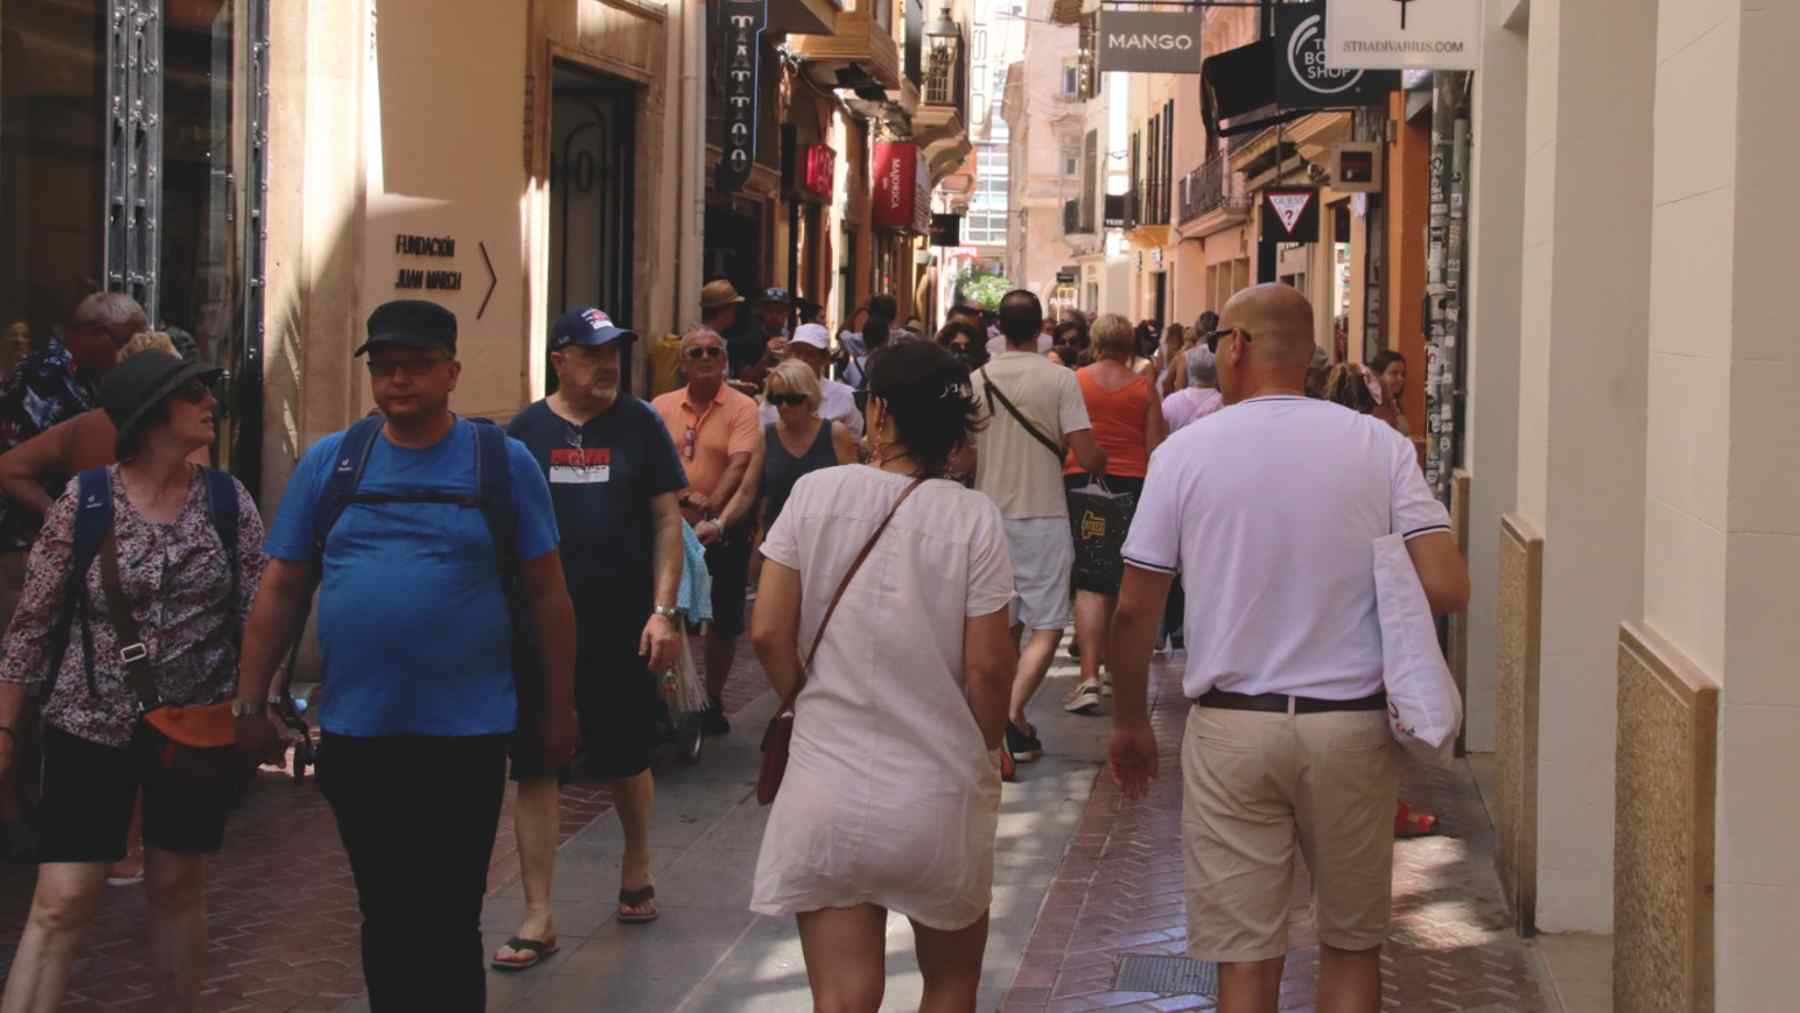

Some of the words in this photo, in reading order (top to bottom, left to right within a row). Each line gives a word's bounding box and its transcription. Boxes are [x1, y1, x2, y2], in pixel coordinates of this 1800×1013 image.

[1108, 33, 1192, 50] MANGO
[1343, 40, 1464, 53] STRADIVARIUS.COM
[730, 15, 754, 173] TATTOO
[889, 158, 901, 208] MAJORICA
[396, 234, 455, 257] FUNDACIÓN
[395, 268, 424, 288] JUAN
[426, 270, 462, 290] MARCH
